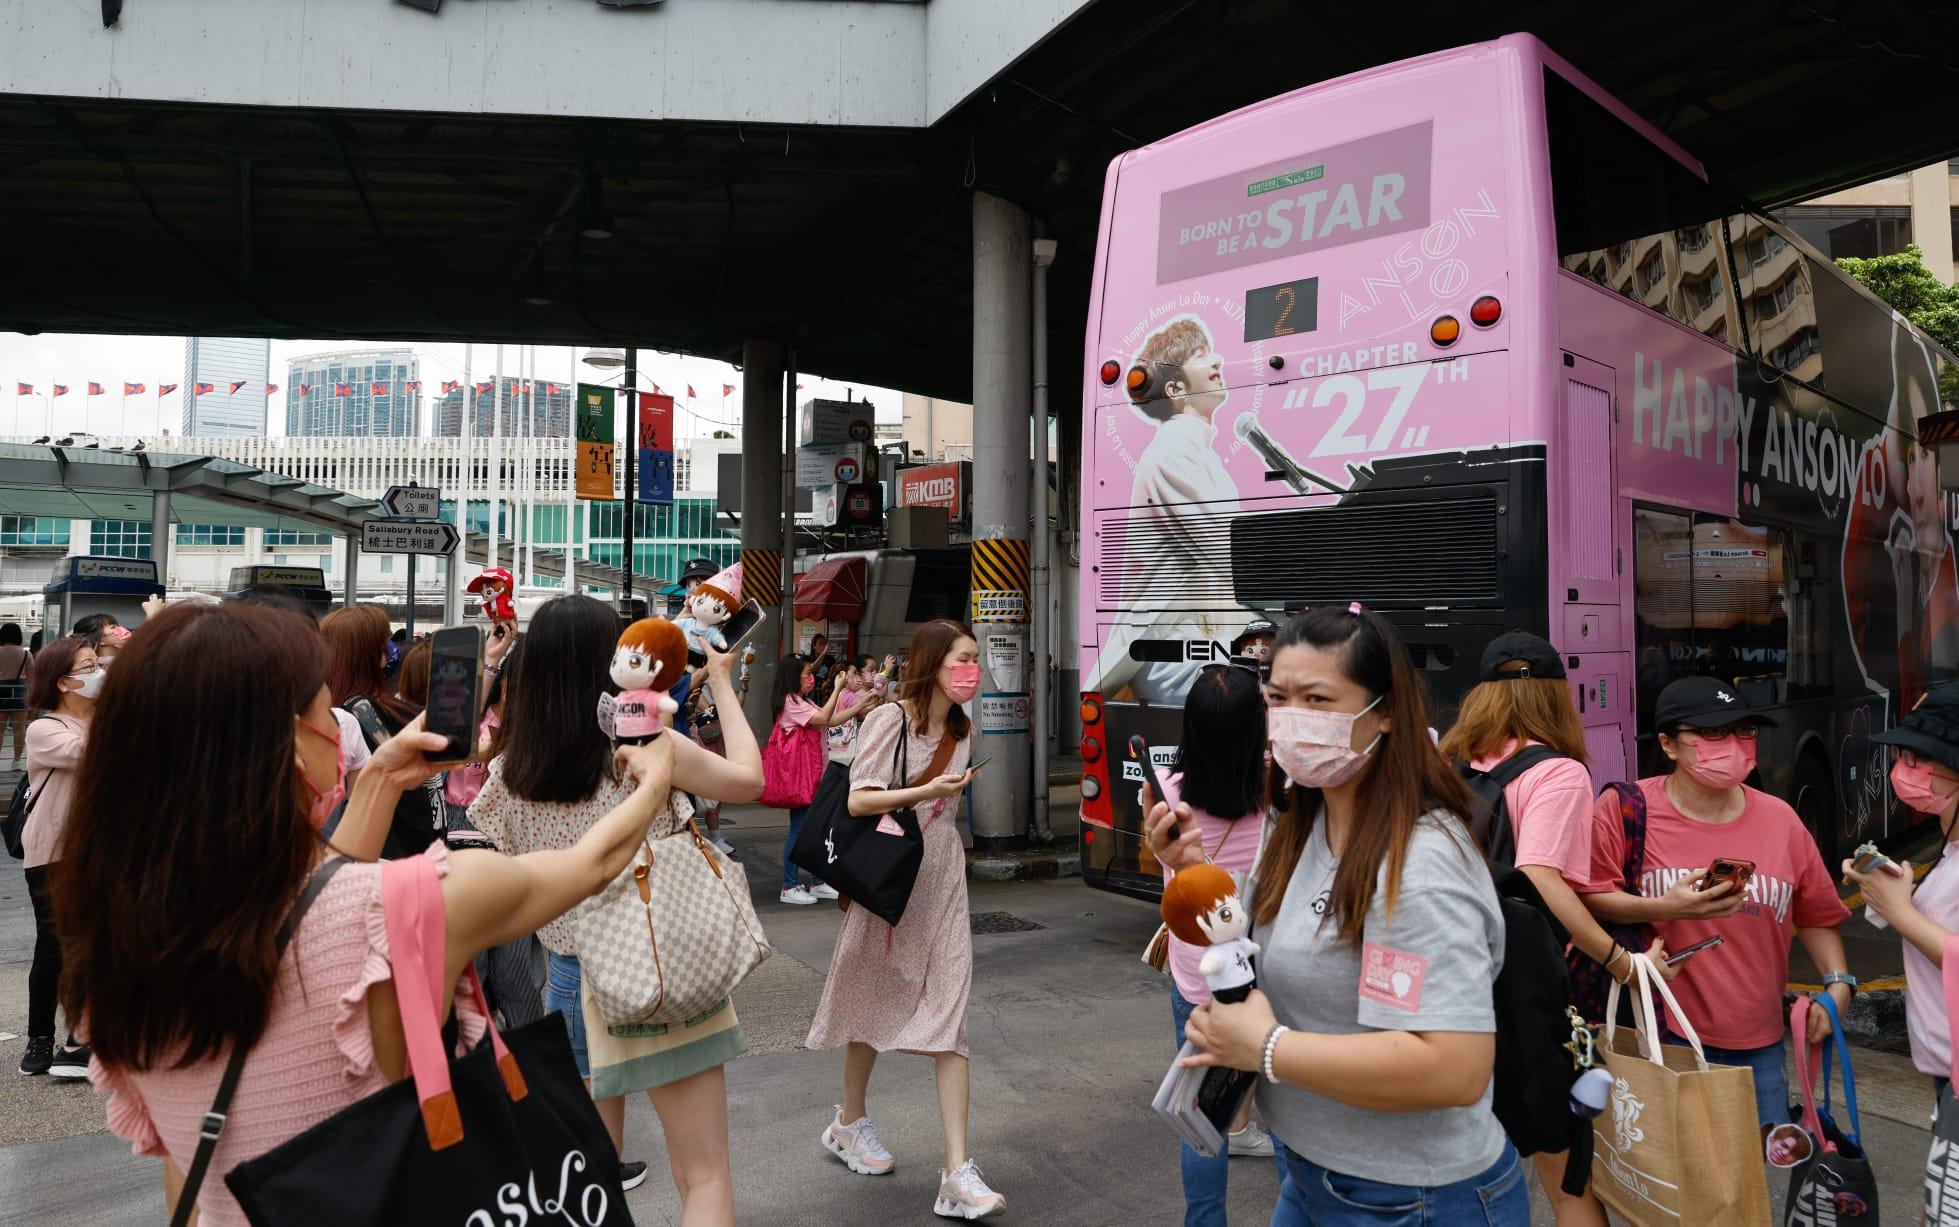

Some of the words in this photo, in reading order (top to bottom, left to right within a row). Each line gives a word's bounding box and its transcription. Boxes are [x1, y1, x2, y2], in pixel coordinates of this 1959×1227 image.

[1262, 172, 1406, 249] STAR
[1179, 217, 1233, 246] BORN
[1237, 209, 1263, 231] TO
[1216, 235, 1240, 256] BE
[1244, 231, 1258, 250] A
[1121, 317, 1151, 347] Happy
[1150, 298, 1177, 320] Anson
[1179, 293, 1191, 307] Lo
[1192, 291, 1212, 311] Day
[1273, 286, 1297, 337] 2
[1300, 341, 1420, 378] CHAPTER
[1434, 358, 1470, 385] TH
[1632, 351, 1757, 472] HAPPY
[1761, 405, 1858, 499] ANSON
[403, 490, 435, 500] Toilets
[368, 525, 413, 536] Salisbury
[415, 526, 440, 536] Road
[368, 536, 436, 550] 梳士巴利道
[99, 565, 126, 573] PCCW
